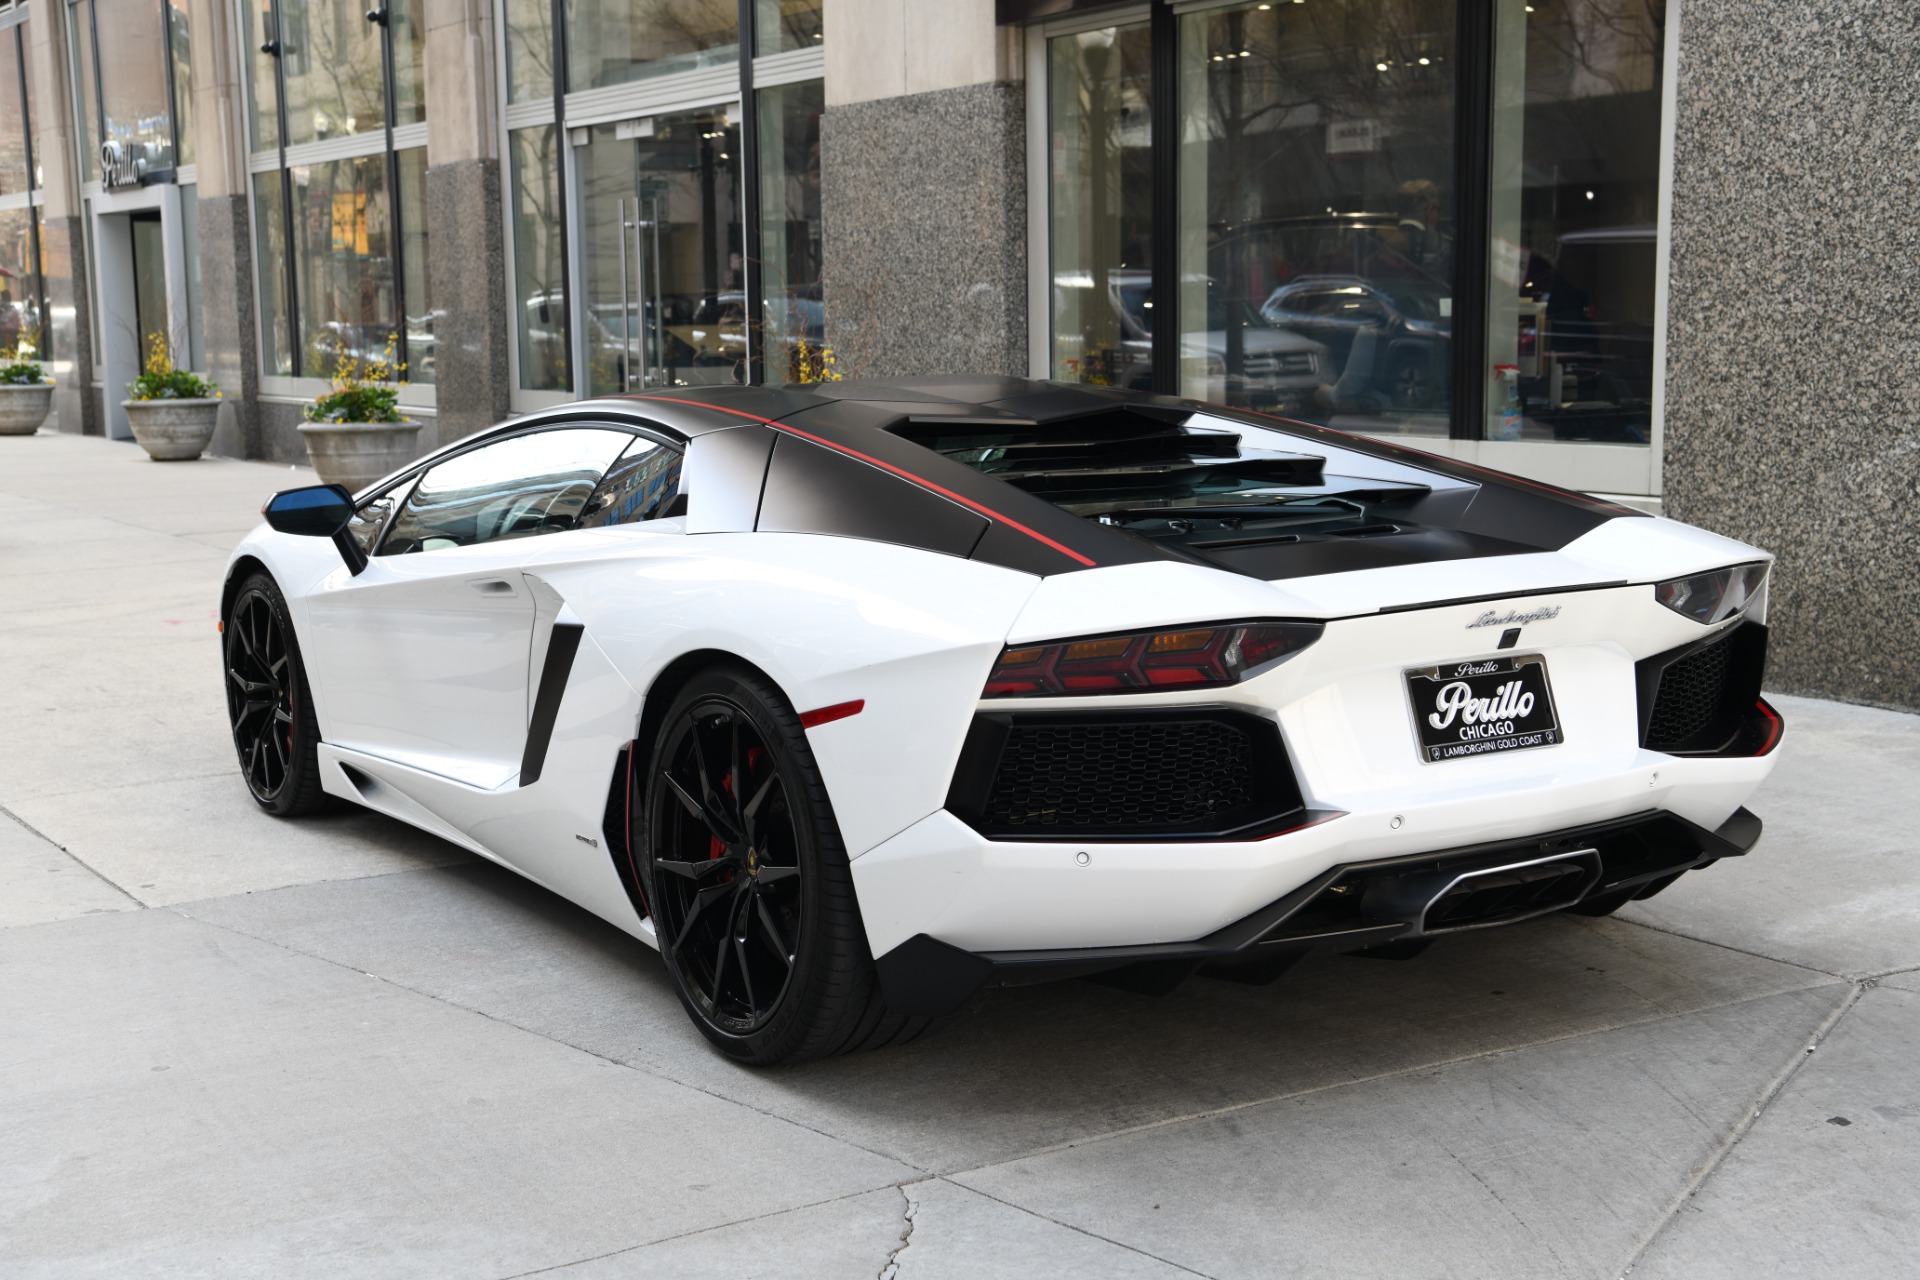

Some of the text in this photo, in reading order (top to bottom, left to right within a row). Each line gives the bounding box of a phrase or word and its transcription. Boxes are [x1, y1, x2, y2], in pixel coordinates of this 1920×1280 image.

[101, 141, 139, 192] Perillo
[1465, 605, 1562, 629] Lamborghini
[1454, 661, 1499, 677] Perillo
[1428, 680, 1535, 730] Perillo
[1459, 720, 1515, 740] CHICAGO
[1443, 734, 1542, 757] LAMBORGHINI GOLD COAST
